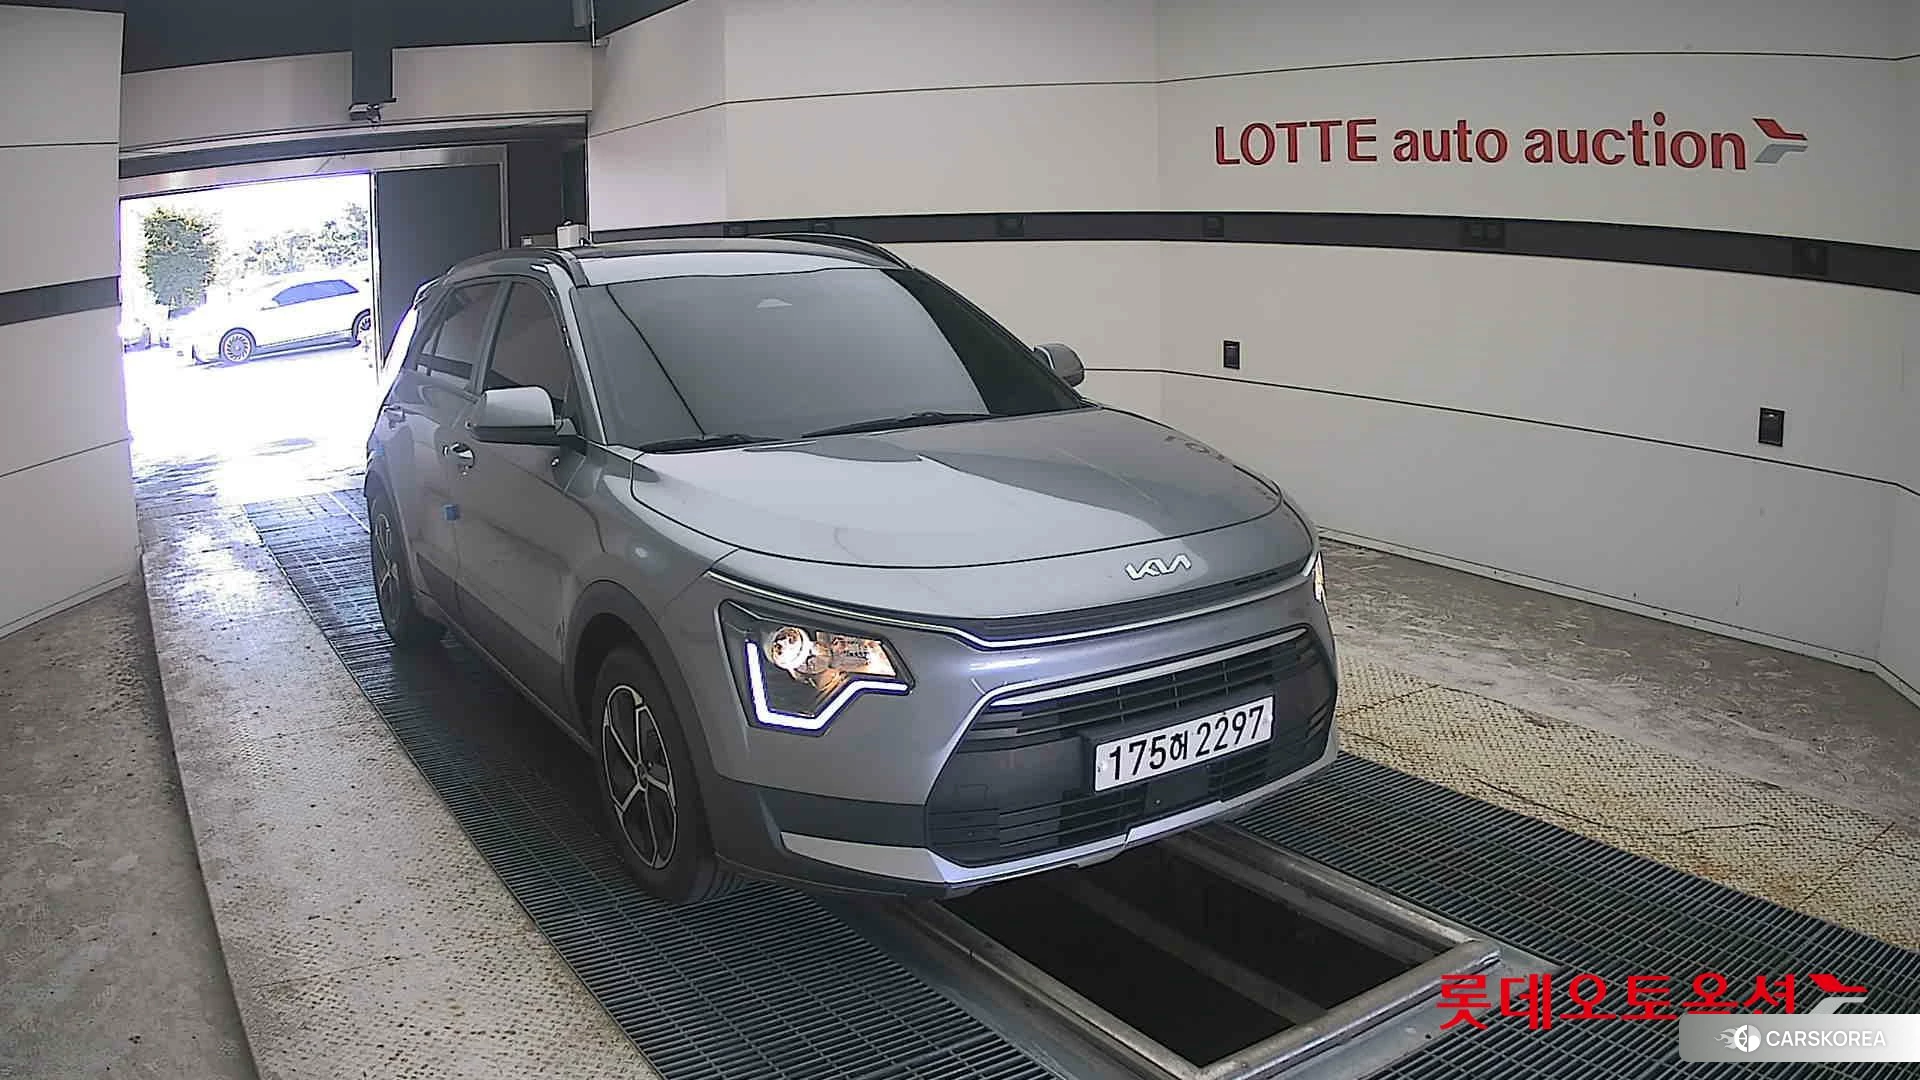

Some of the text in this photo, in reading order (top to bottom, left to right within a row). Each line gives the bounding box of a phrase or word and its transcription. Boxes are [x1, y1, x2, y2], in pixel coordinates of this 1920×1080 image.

[1215, 111, 1747, 170] LOTTE auto auction
[1195, 705, 1265, 757] 2297
